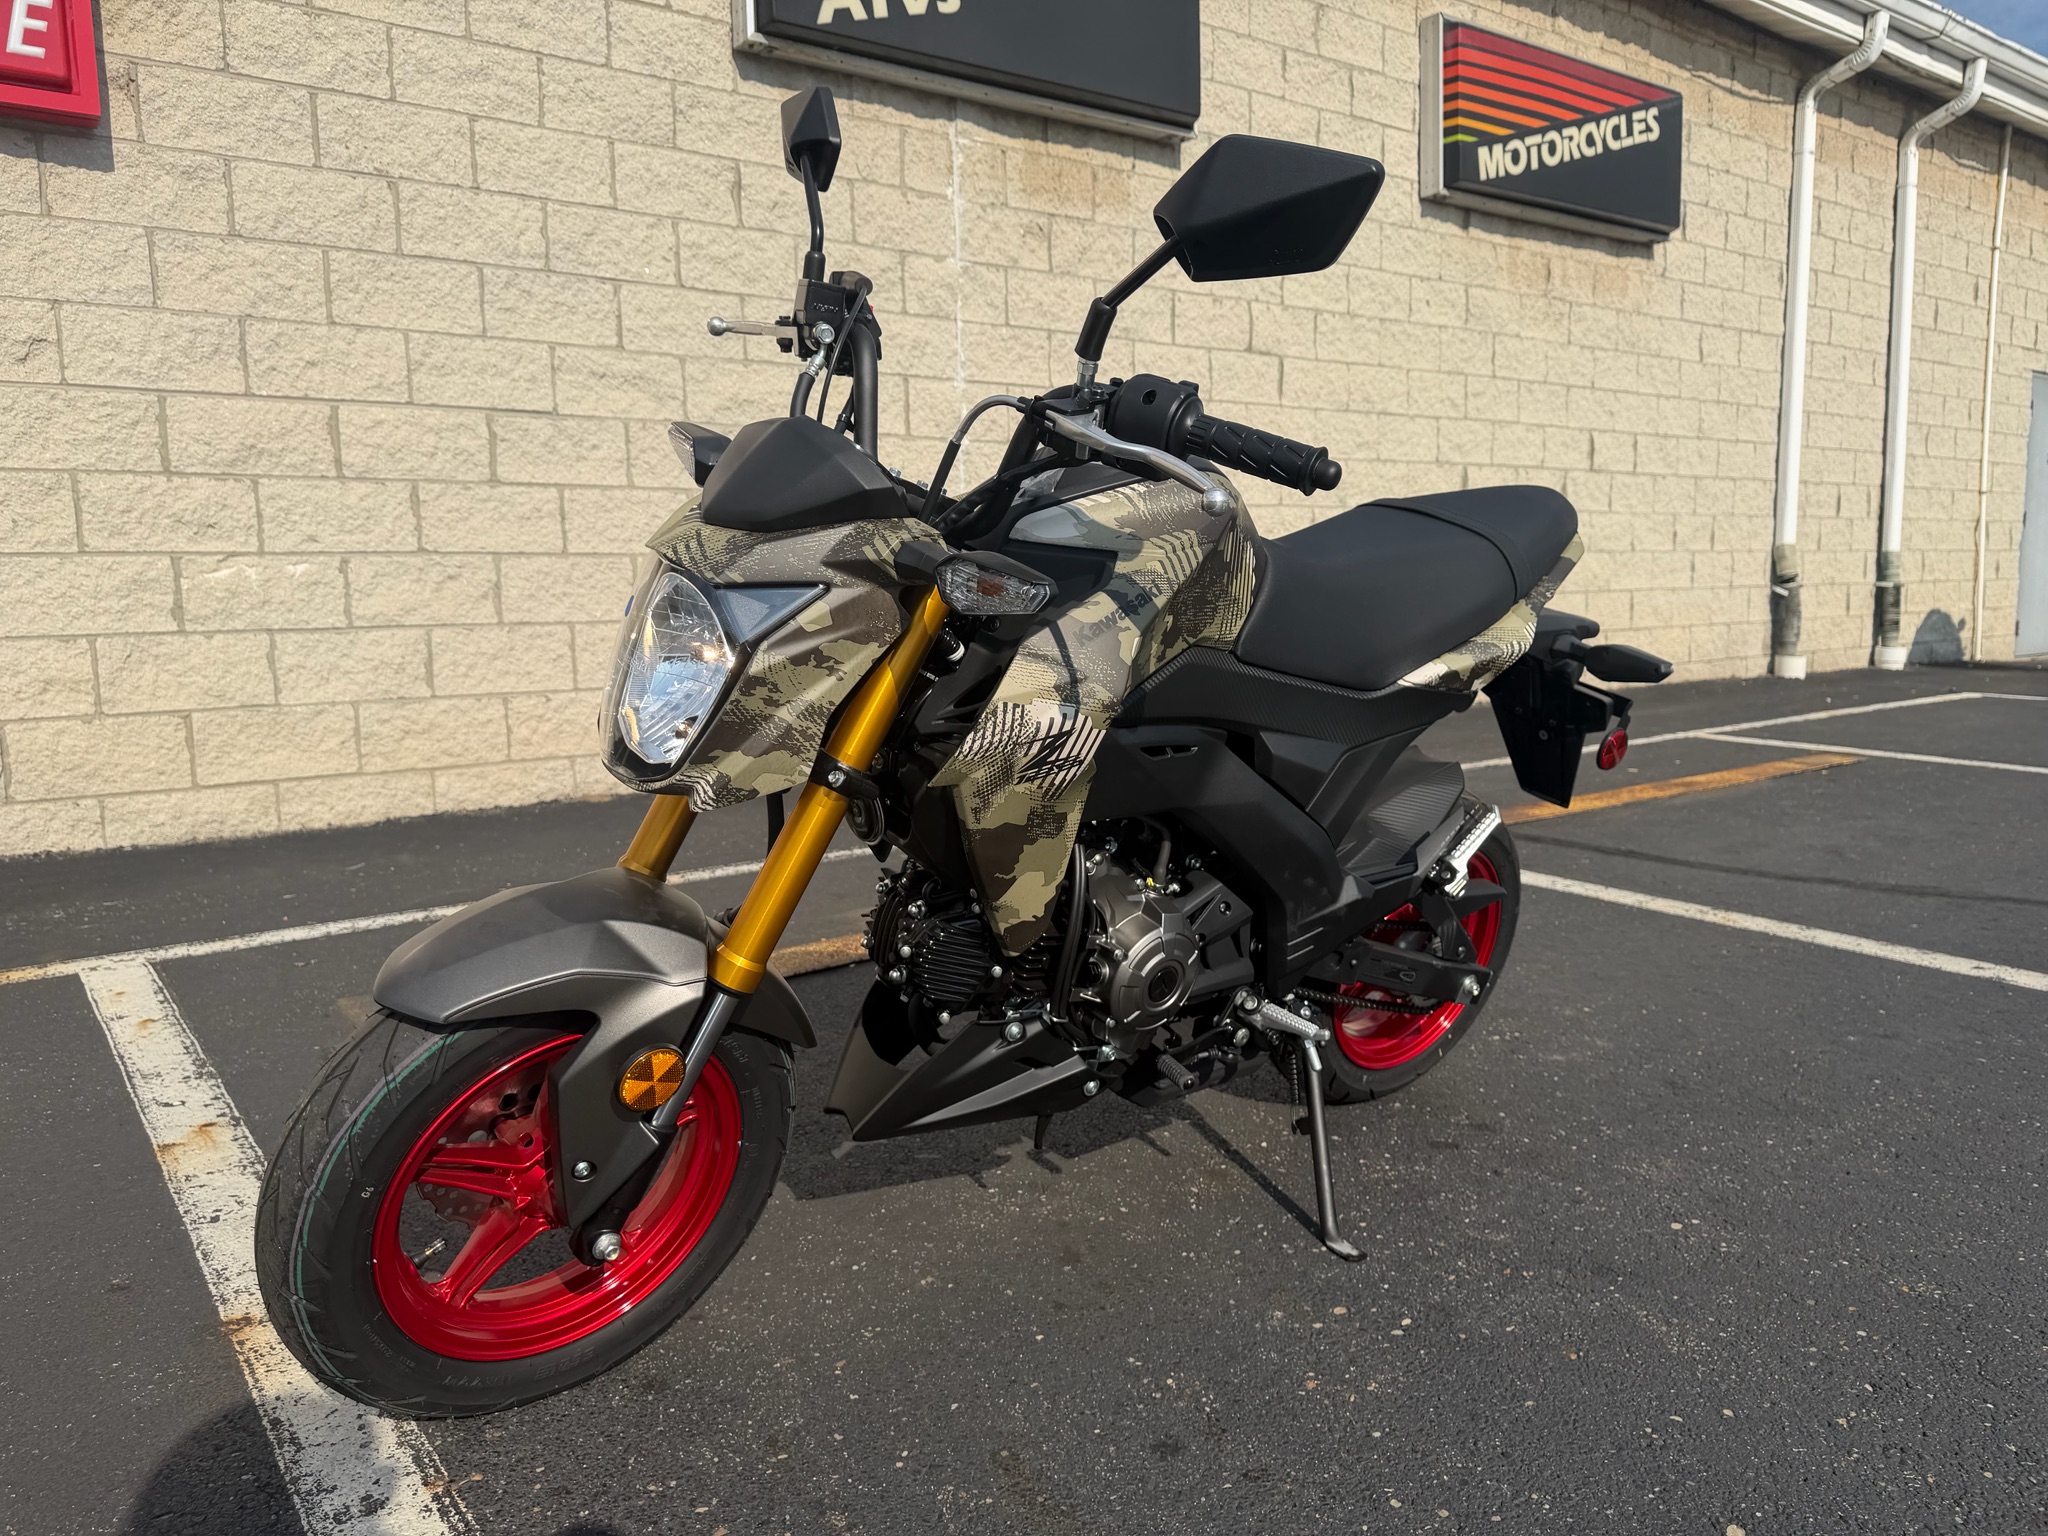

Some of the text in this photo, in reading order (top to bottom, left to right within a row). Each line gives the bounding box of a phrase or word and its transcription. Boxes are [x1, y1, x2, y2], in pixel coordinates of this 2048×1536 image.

[6, 0, 53, 59] E
[1477, 106, 1661, 182] MOTORCYCLES
[1073, 576, 1163, 648] Kawasaki
